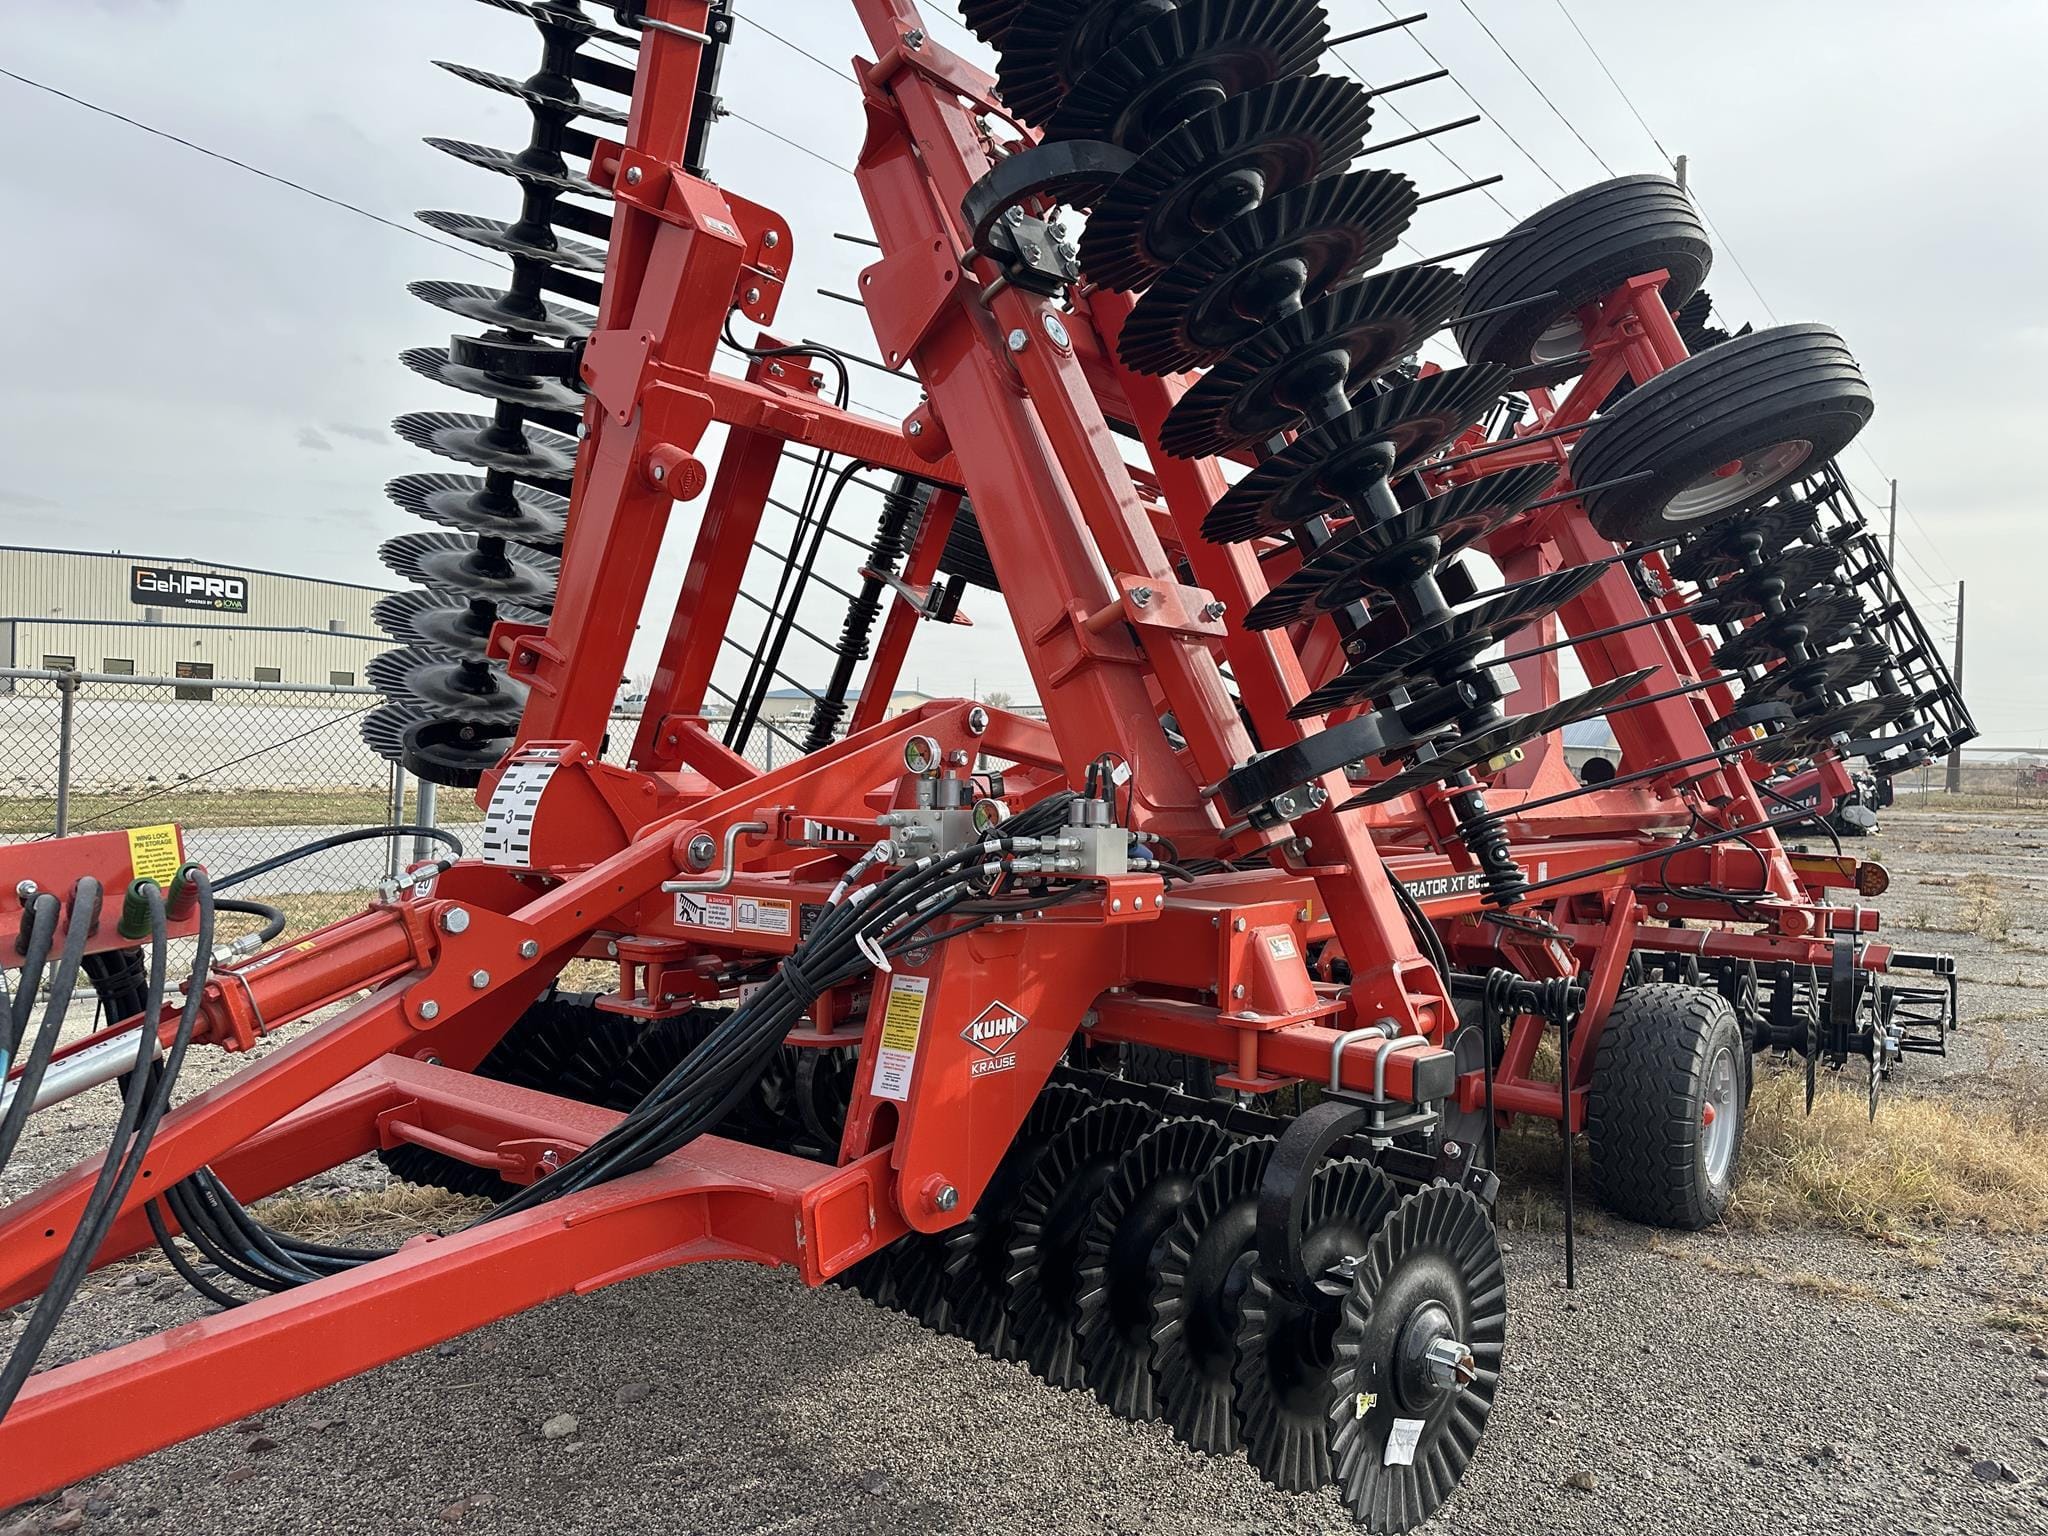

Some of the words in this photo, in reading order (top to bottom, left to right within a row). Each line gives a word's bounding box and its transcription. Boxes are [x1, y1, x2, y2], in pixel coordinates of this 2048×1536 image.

[136, 570, 243, 599] GehlPRO
[224, 599, 242, 608] IOWA
[515, 780, 526, 794] 5
[505, 809, 514, 824] 3
[145, 839, 172, 847] STORAGE
[503, 838, 509, 854] 1
[1450, 876, 1466, 892] XT
[972, 1016, 1017, 1040] KUHN
[971, 1056, 1015, 1074] KRAUSE
